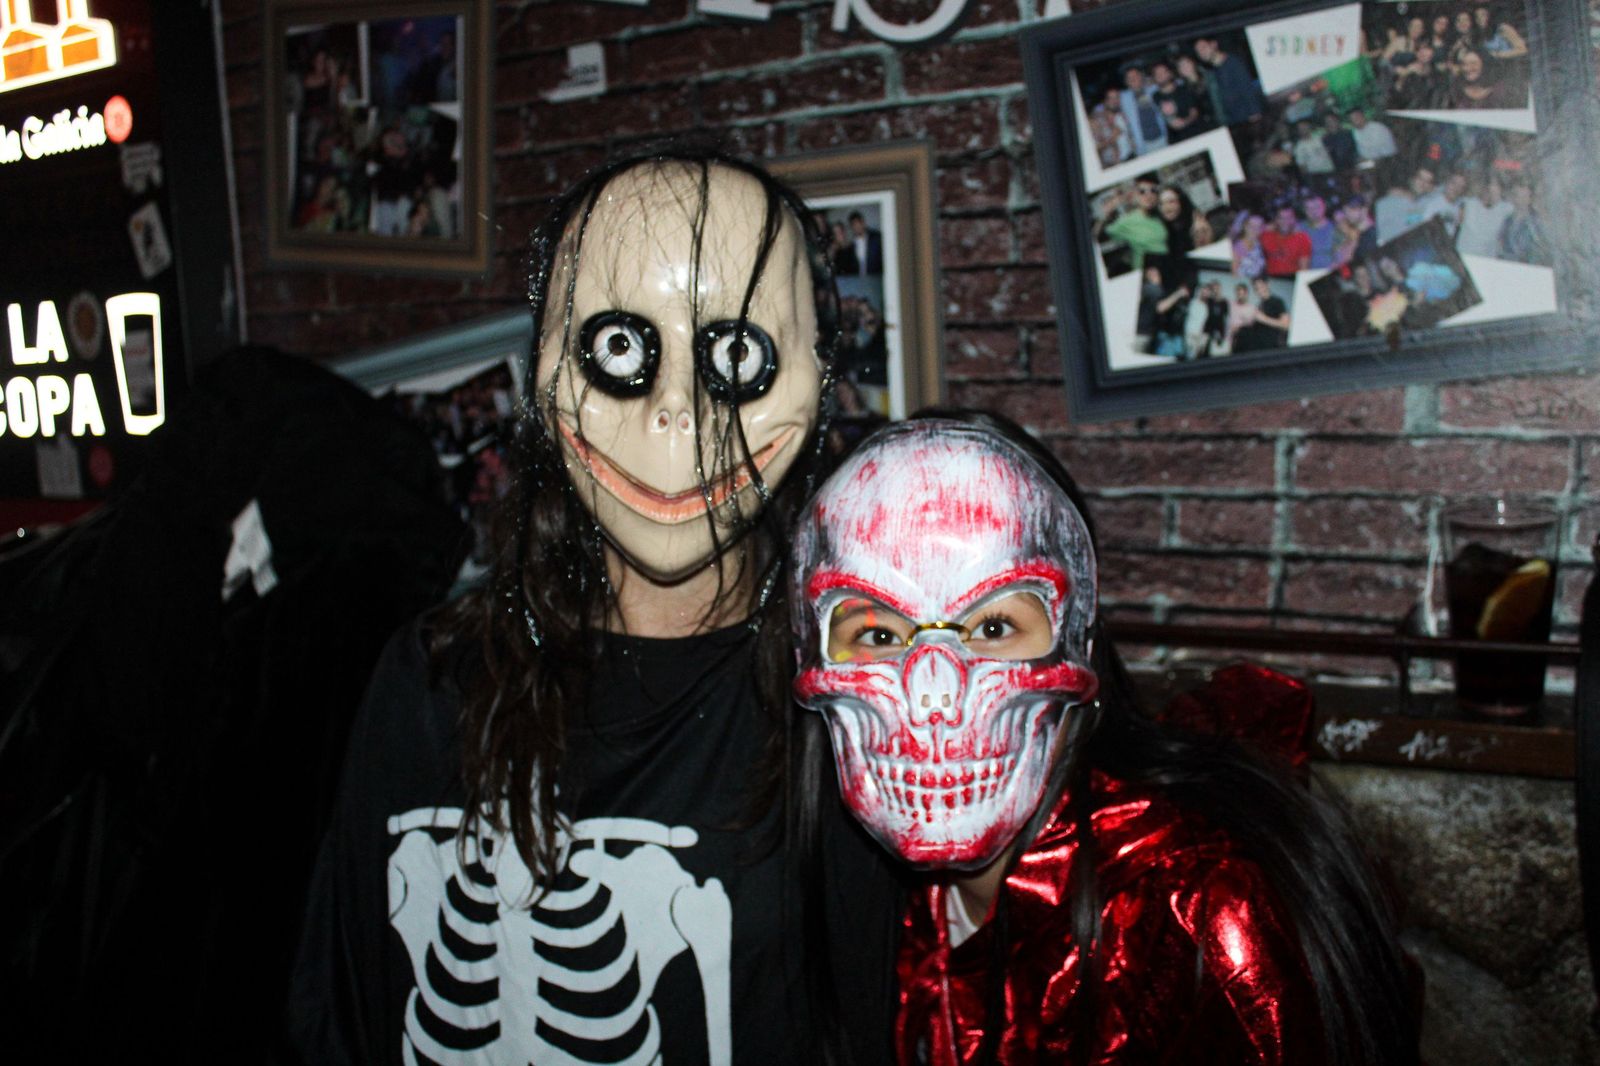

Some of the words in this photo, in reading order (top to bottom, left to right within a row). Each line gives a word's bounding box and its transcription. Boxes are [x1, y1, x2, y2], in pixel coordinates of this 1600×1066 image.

[1265, 33, 1346, 57] SYDNEY
[7, 300, 69, 366] LA
[0, 372, 106, 439] OPA
